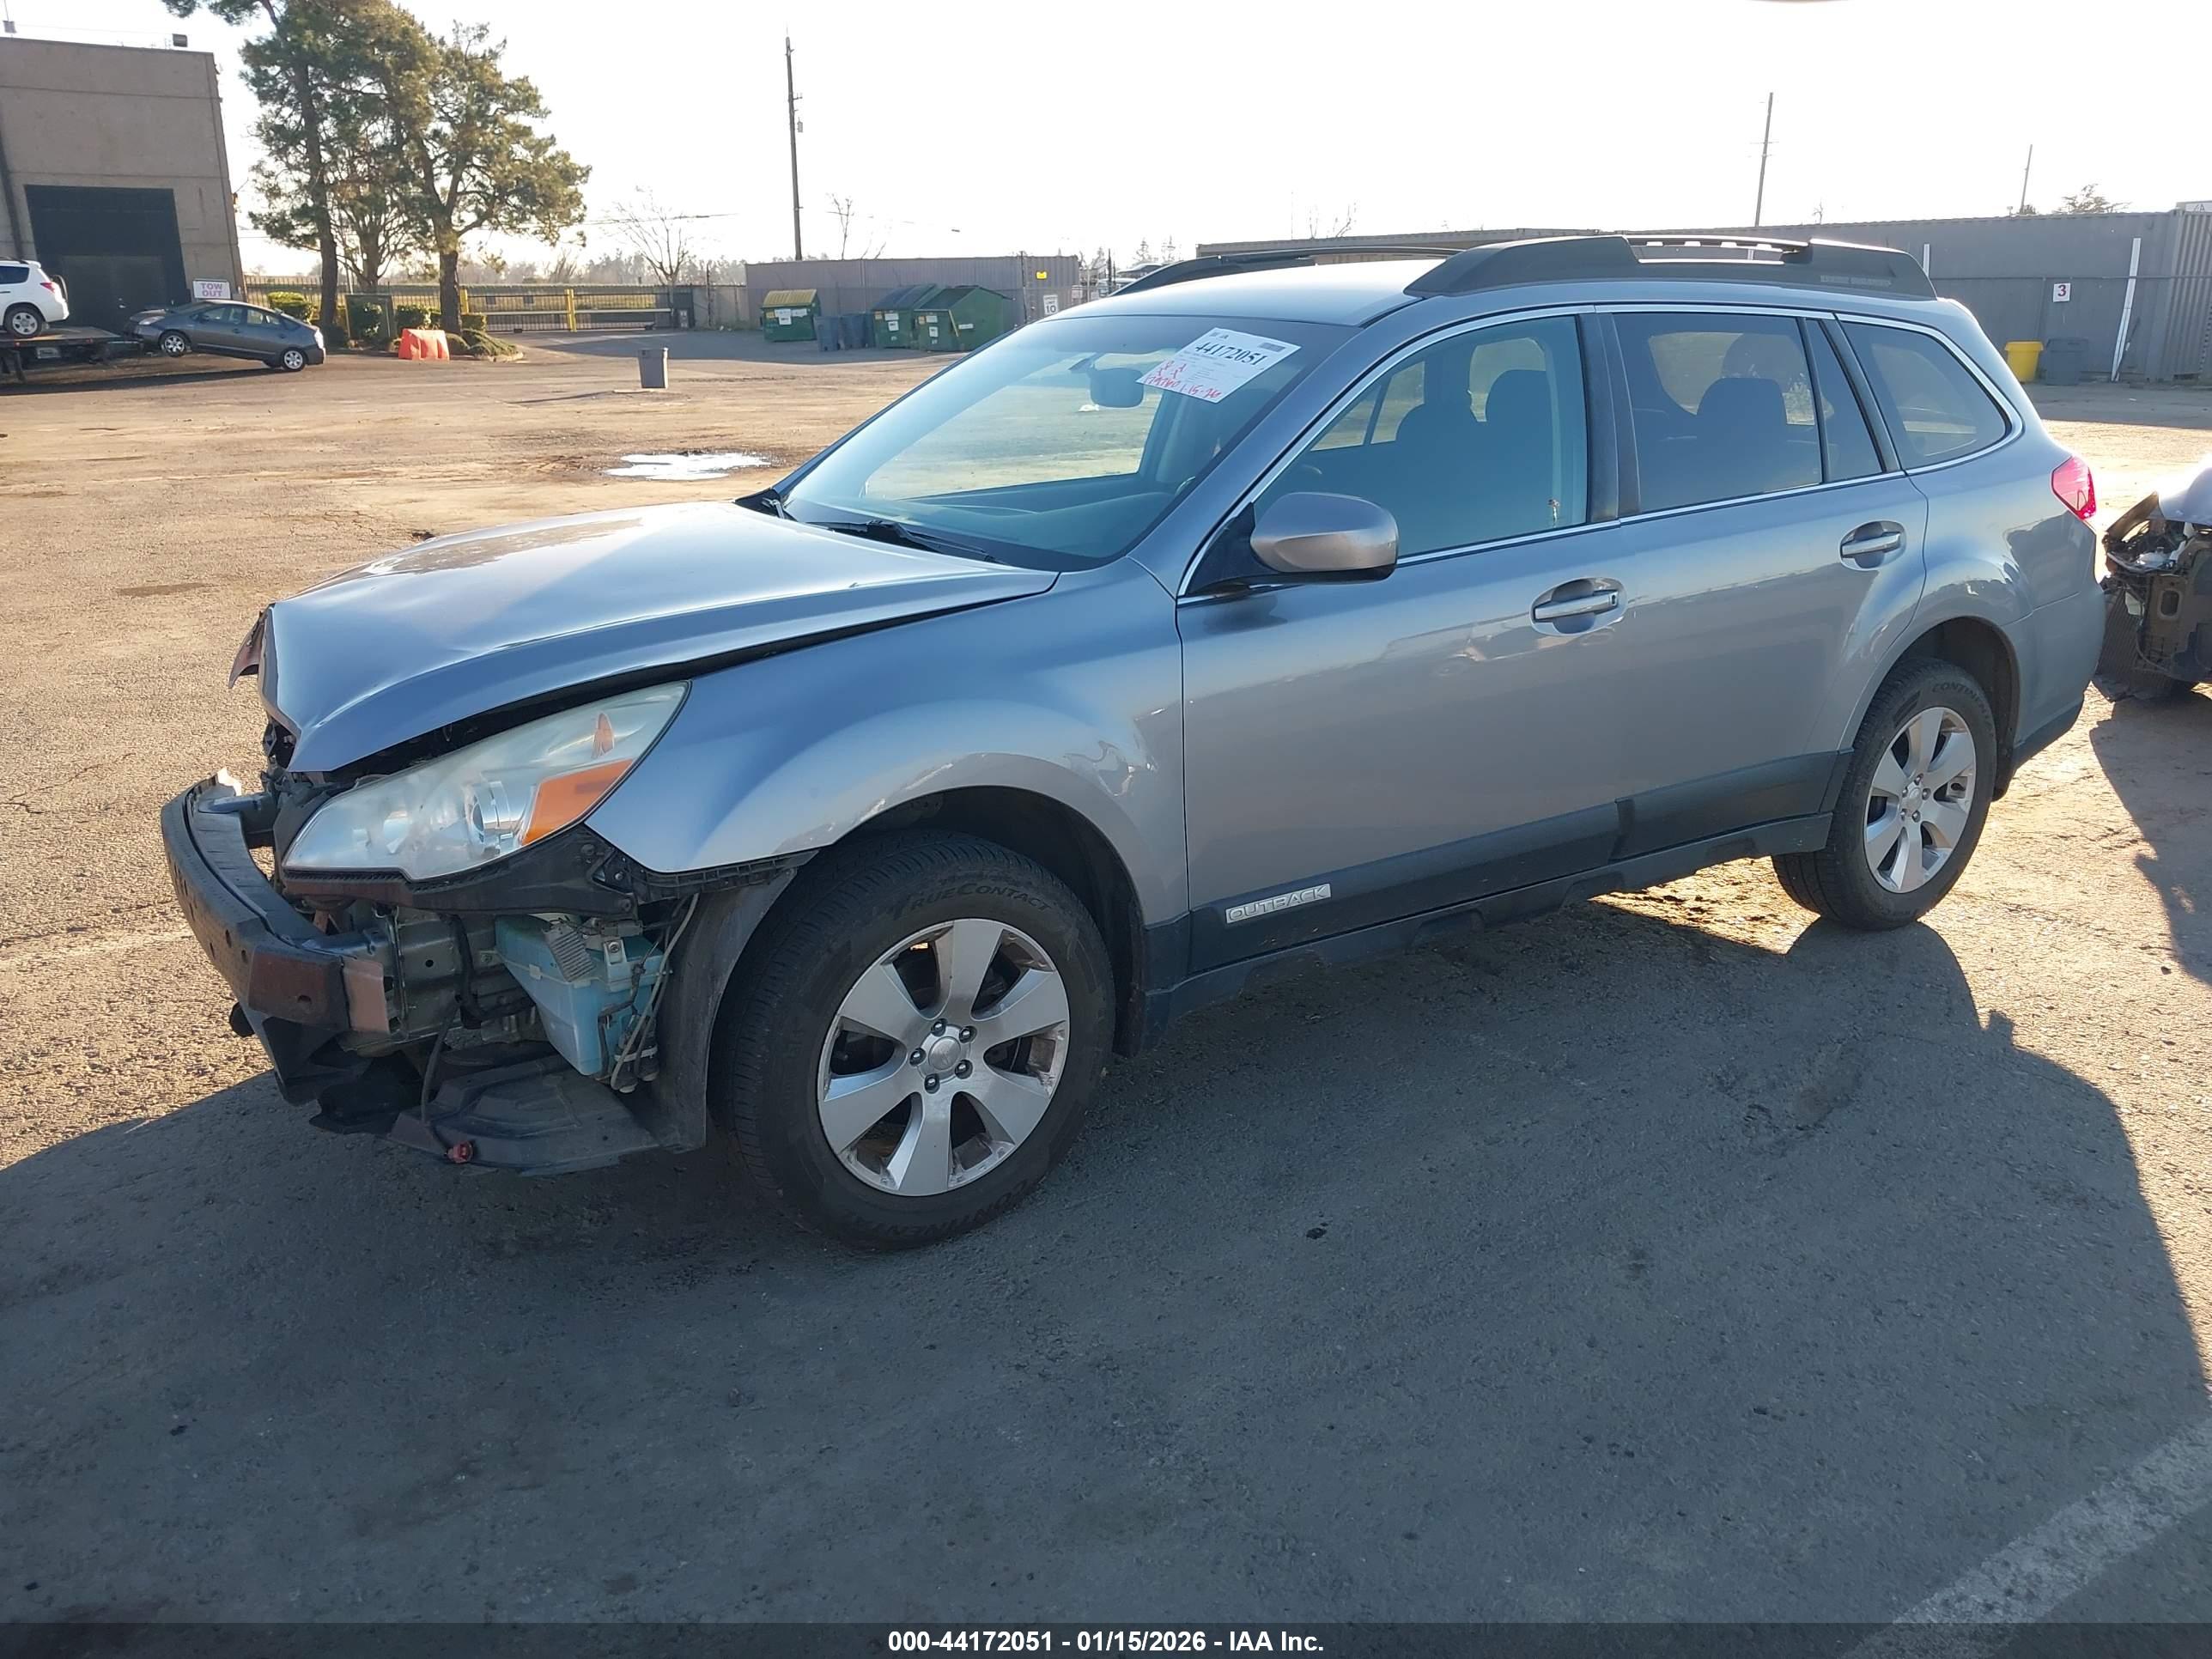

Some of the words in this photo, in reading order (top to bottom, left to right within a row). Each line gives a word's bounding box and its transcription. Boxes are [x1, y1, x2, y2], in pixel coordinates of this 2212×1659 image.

[2057, 284, 2067, 297] 3
[1194, 341, 1269, 366] 44172051
[1228, 885, 1328, 921] OUTBACK
